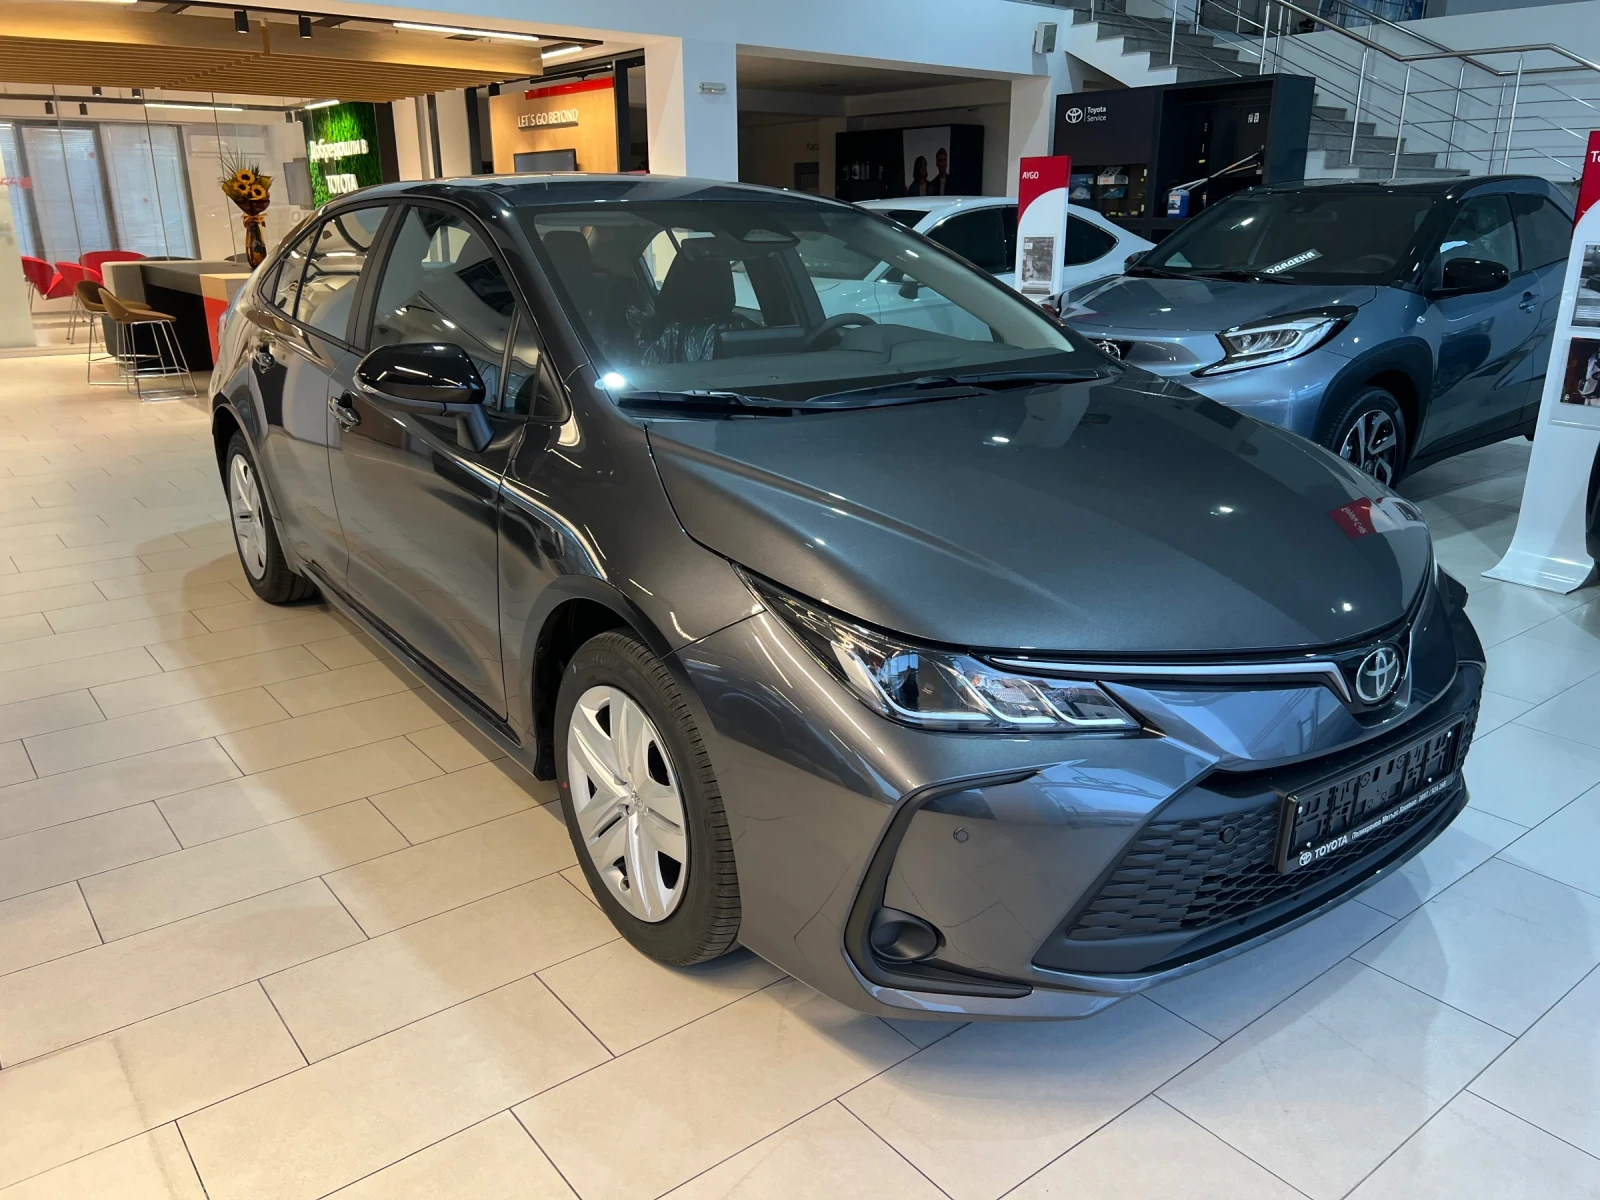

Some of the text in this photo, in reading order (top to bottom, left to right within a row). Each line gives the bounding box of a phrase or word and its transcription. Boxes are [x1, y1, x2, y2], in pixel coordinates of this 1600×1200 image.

[517, 108, 579, 128] LET'S GO BEYOND
[1087, 106, 1107, 115] Toyota
[325, 173, 360, 194] TOYOTA
[1021, 171, 1040, 180] AYGO
[1314, 835, 1348, 858] TOYOTA
